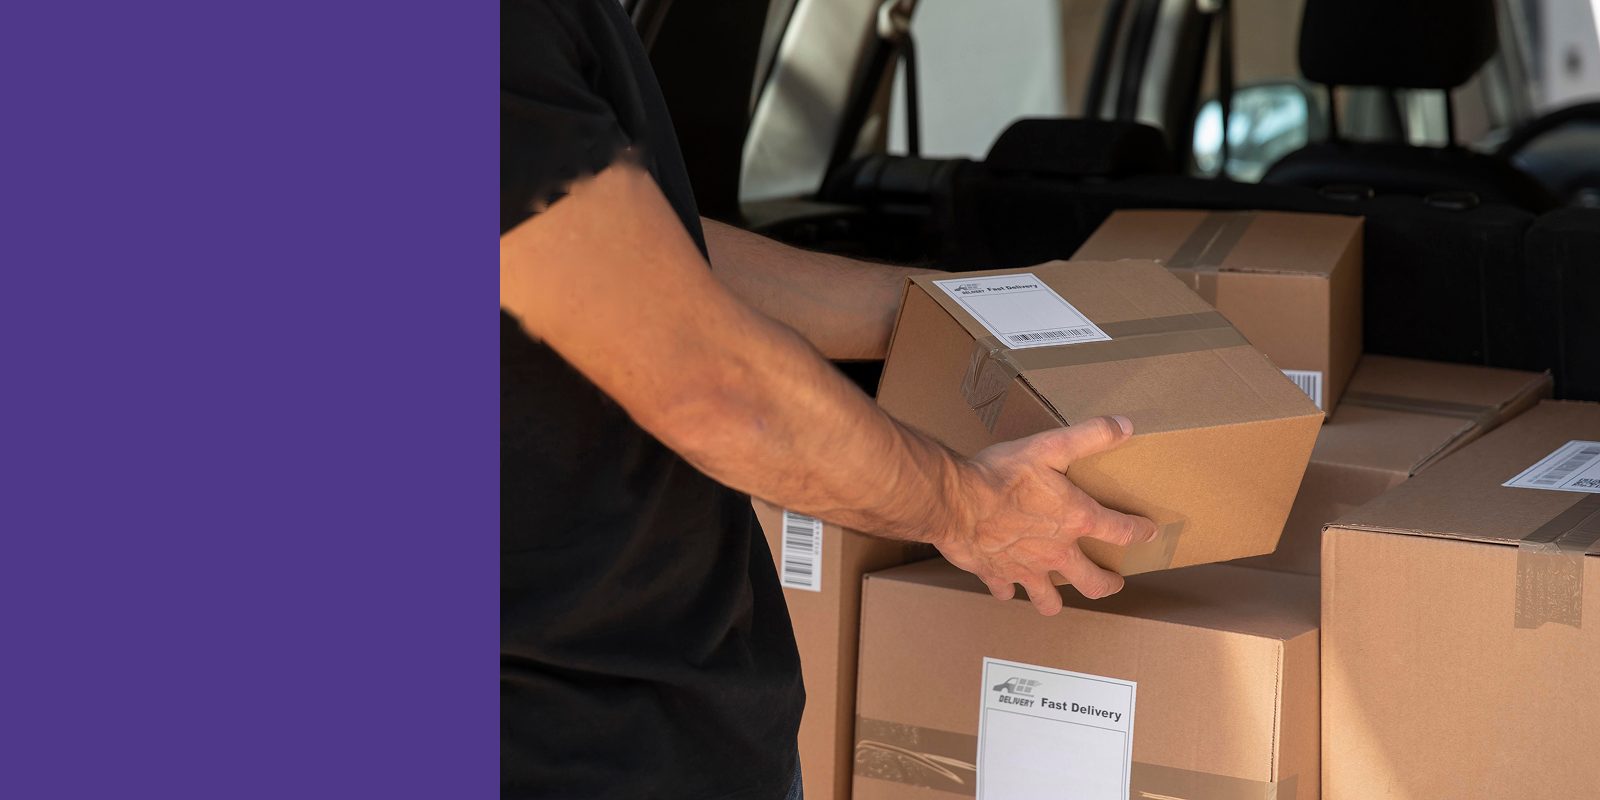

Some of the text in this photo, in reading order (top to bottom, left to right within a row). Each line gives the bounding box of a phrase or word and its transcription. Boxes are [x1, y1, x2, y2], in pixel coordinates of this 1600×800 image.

[1005, 283, 1038, 291] Delivery
[998, 694, 1035, 708] DELIVERY
[1041, 697, 1122, 722] Fast Delivery
